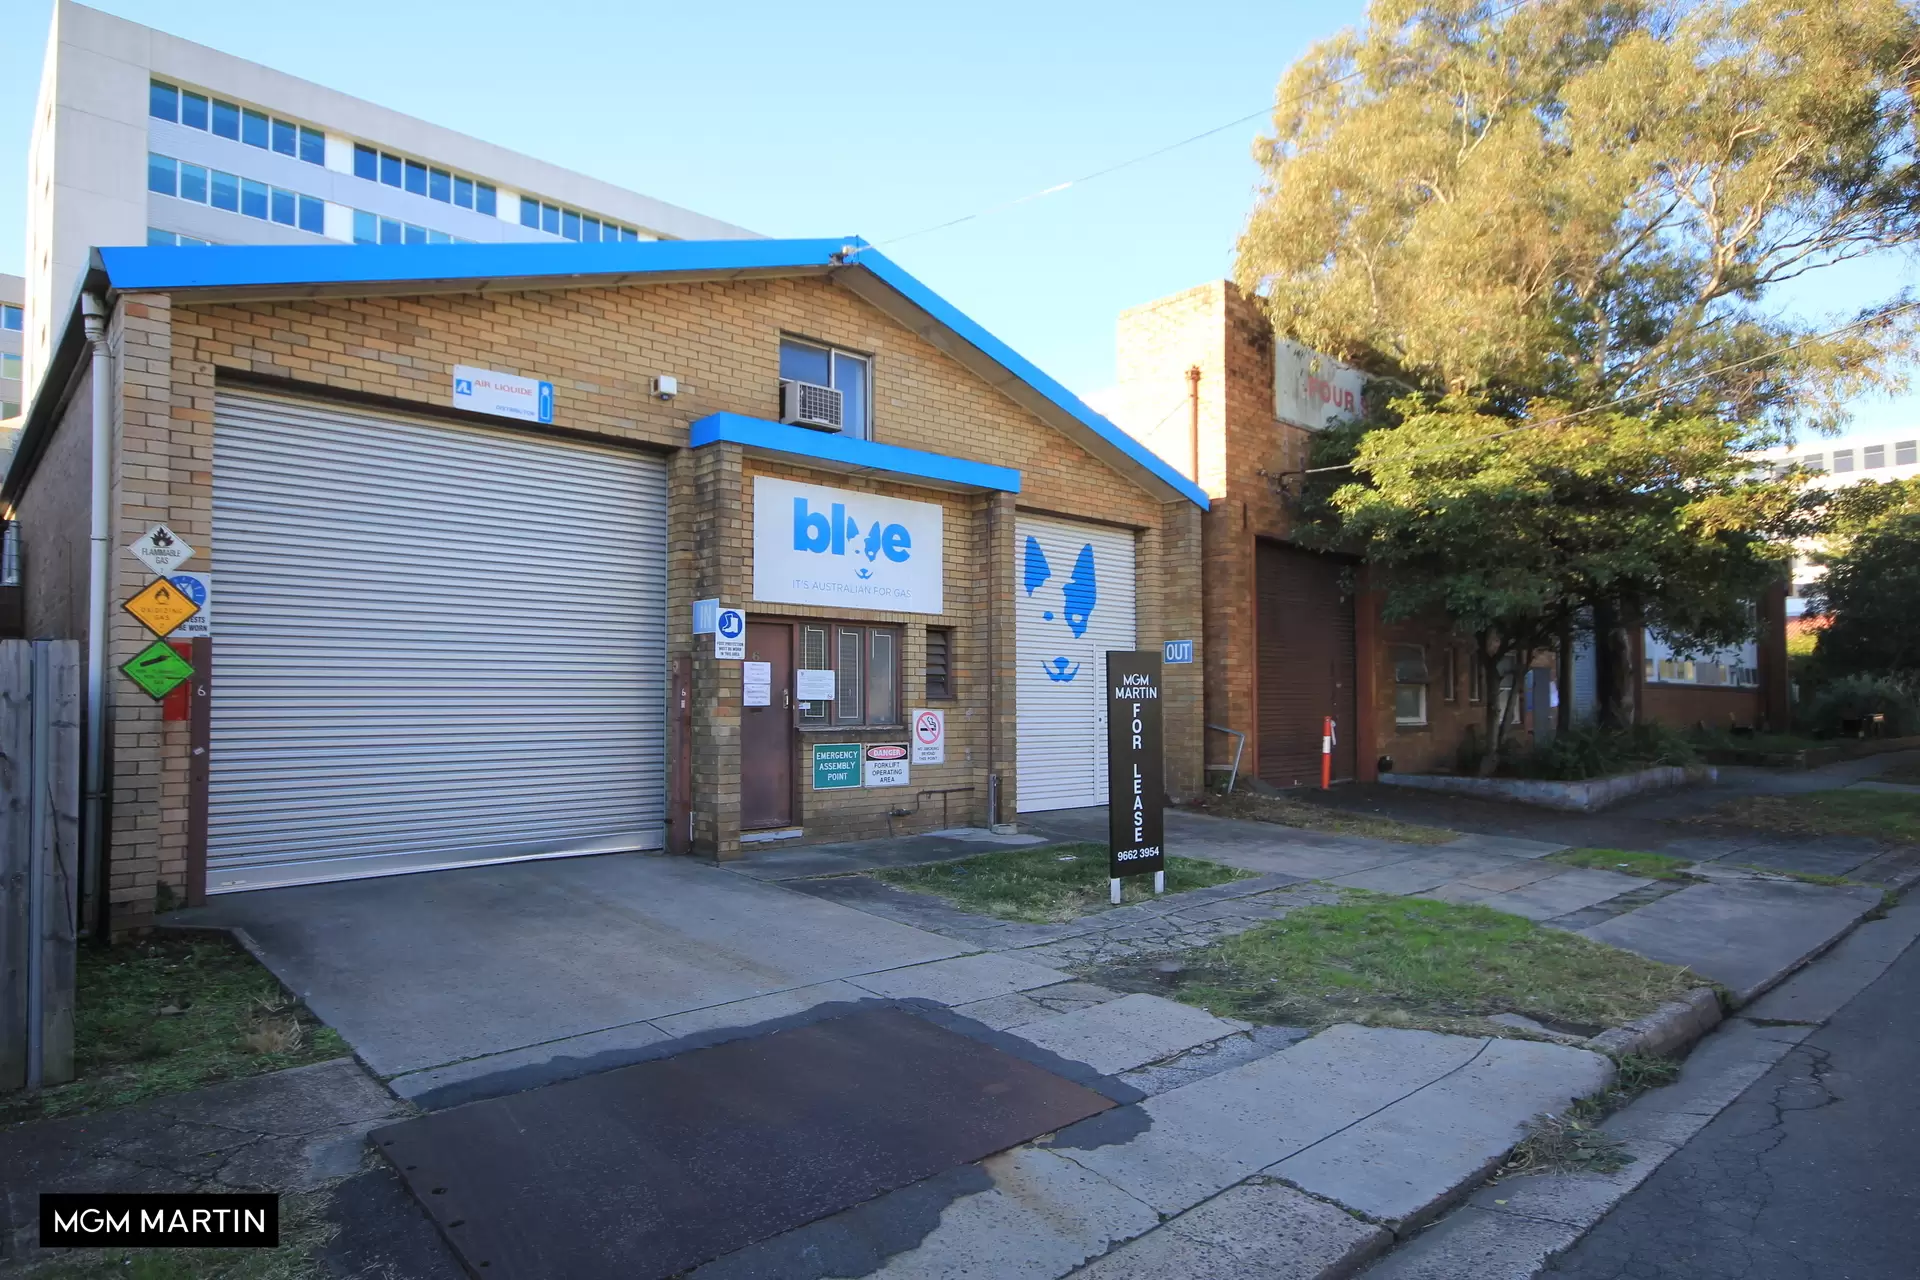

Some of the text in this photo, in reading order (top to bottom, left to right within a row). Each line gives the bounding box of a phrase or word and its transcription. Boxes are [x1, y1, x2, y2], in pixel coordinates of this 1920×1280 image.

[474, 380, 533, 397] AIR LIQUIDE
[793, 497, 912, 564] blue
[141, 547, 181, 558] FLAMMABLE
[155, 556, 169, 565] GAS
[792, 580, 912, 598] IT'S AUSTRALIAN FOR GAS
[701, 605, 713, 629] IN
[1166, 644, 1190, 661] OUT
[1123, 674, 1149, 686] MGM
[197, 685, 207, 697] 6
[681, 688, 687, 697] 6
[1115, 687, 1158, 699] MARTIN
[816, 751, 858, 760] EMERGENCY
[873, 748, 901, 757] DANGER
[819, 762, 856, 771] ASSEMBLY
[827, 773, 848, 781] POINT
[871, 769, 903, 777] OPERATING
[1132, 703, 1143, 843] FOR LEASE
[1117, 846, 1160, 862] 9662 3954
